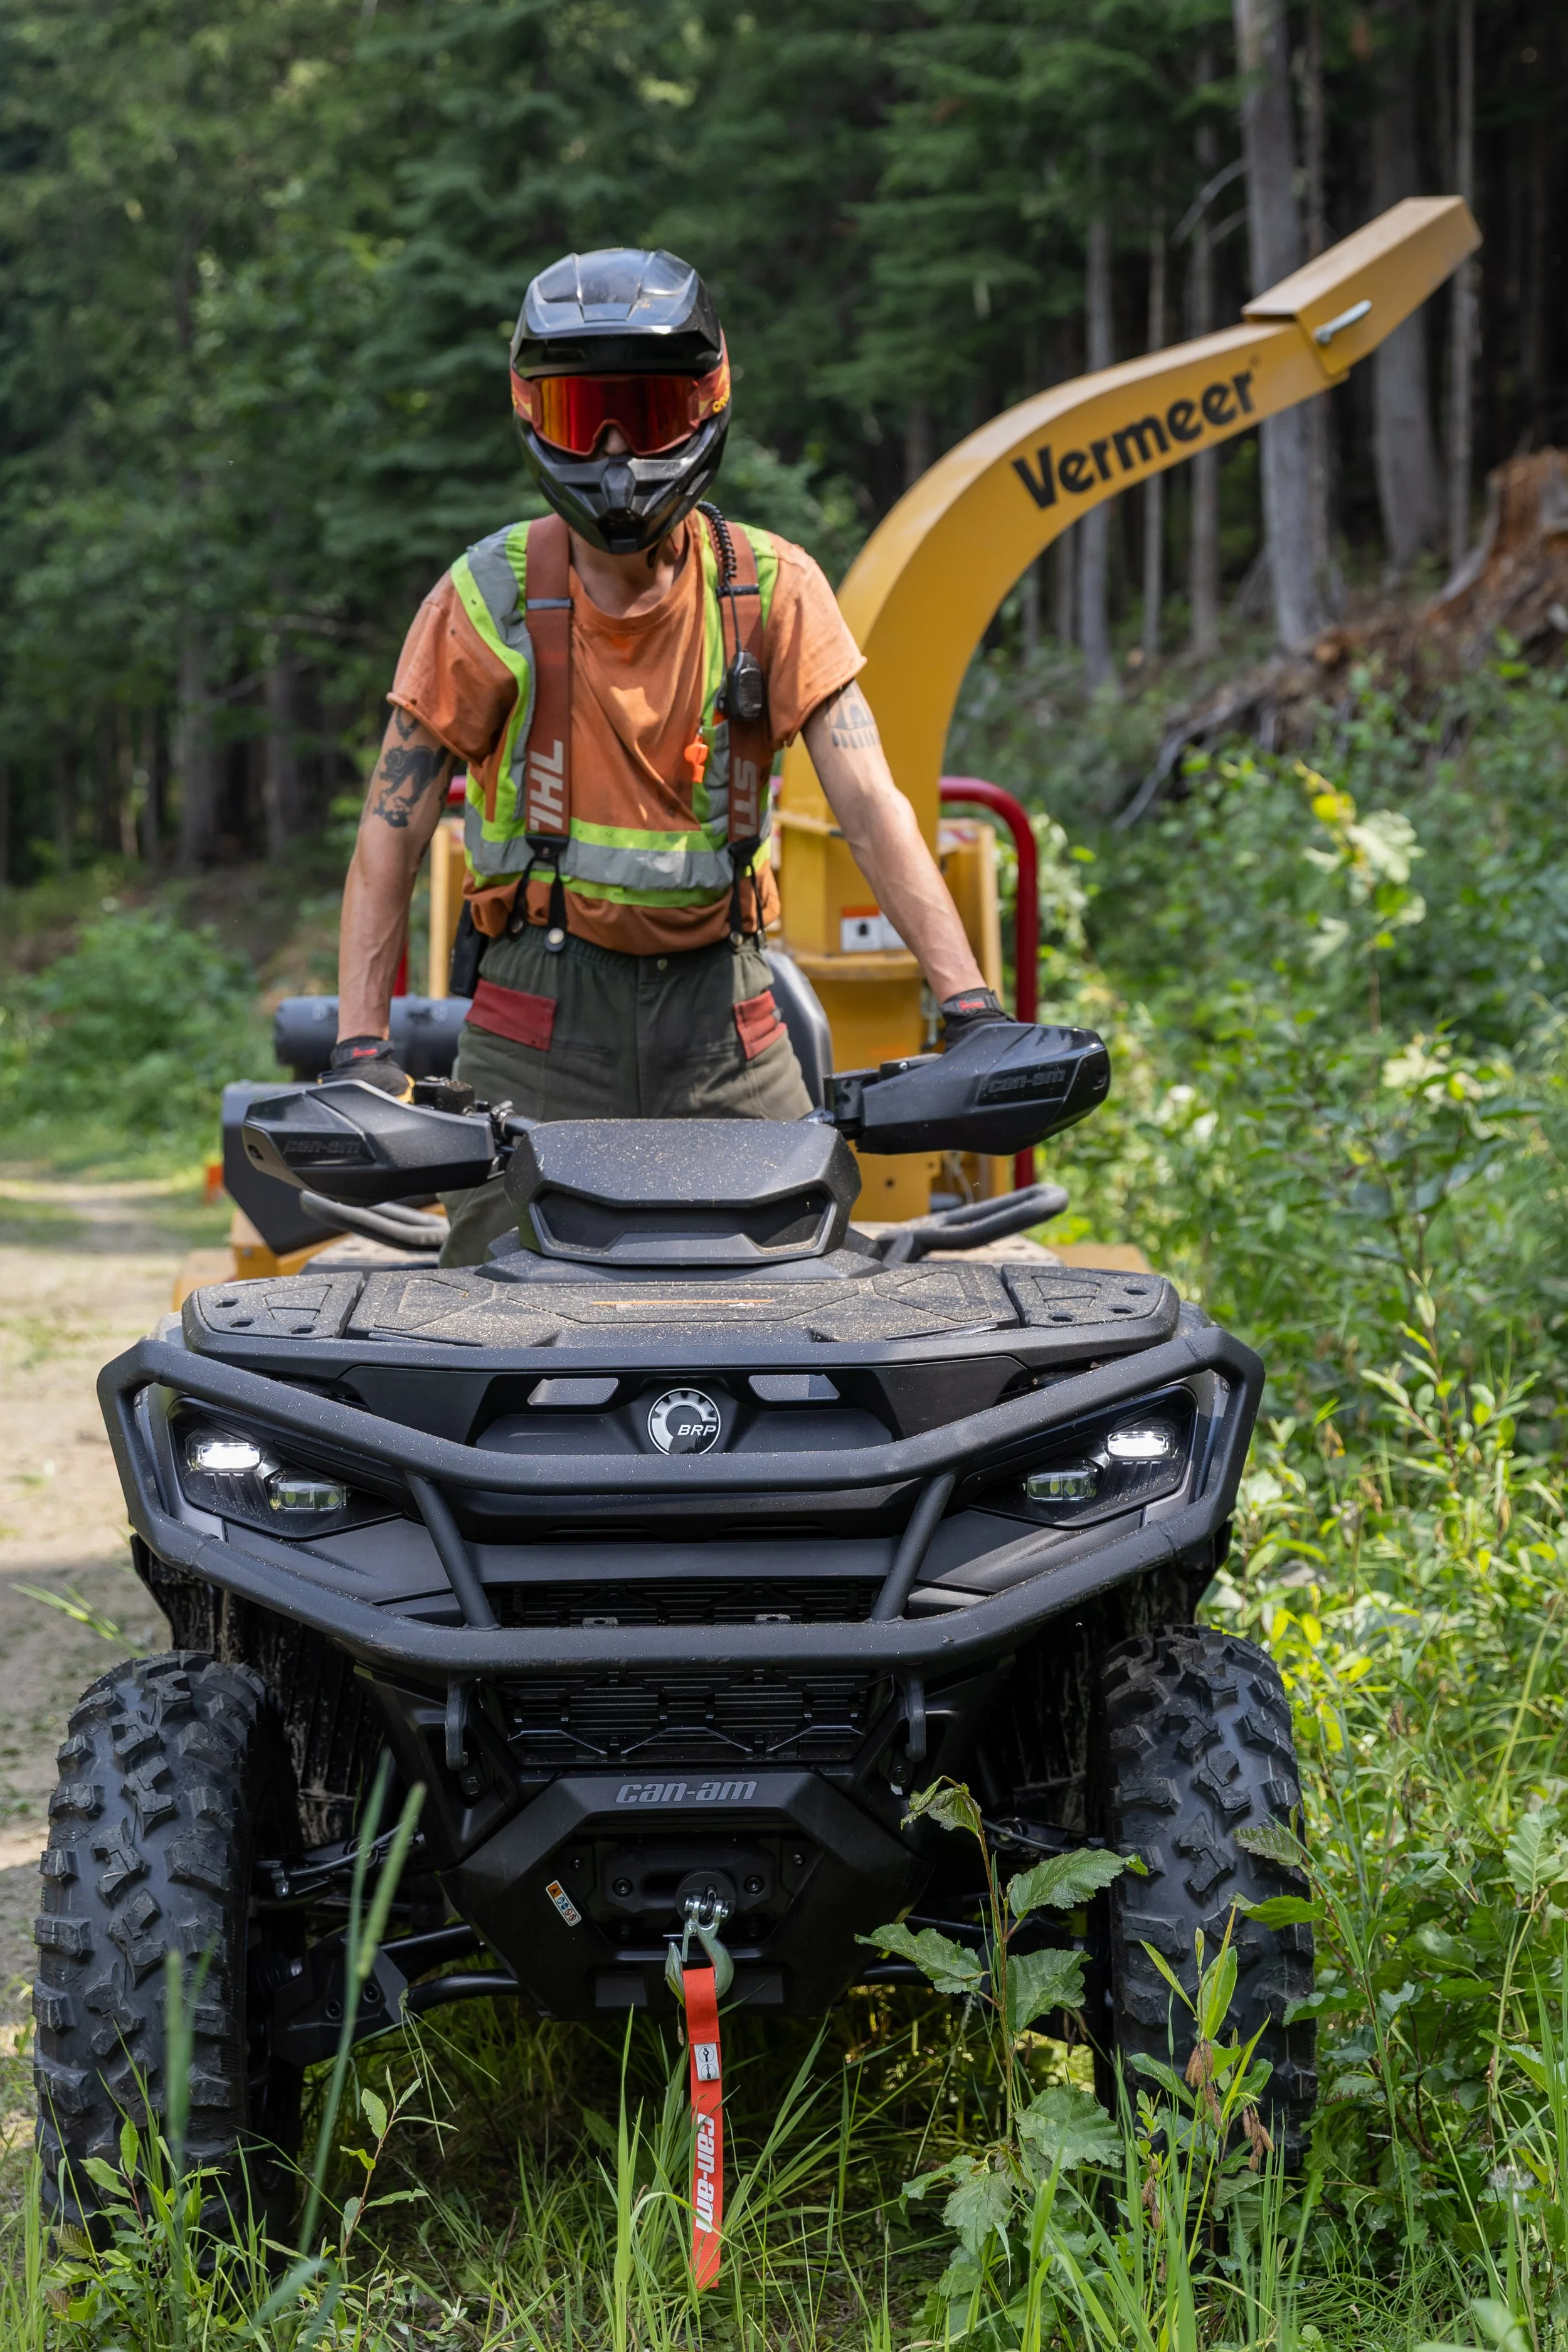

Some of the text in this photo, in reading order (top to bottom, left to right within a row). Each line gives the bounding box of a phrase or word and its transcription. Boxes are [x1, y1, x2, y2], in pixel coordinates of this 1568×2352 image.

[1012, 369, 1255, 511] Vermeer
[988, 1069, 1066, 1093] can-am
[677, 1424, 716, 1436] BRP
[615, 1781, 758, 1803] can-am
[696, 2112, 715, 2233] can-am
